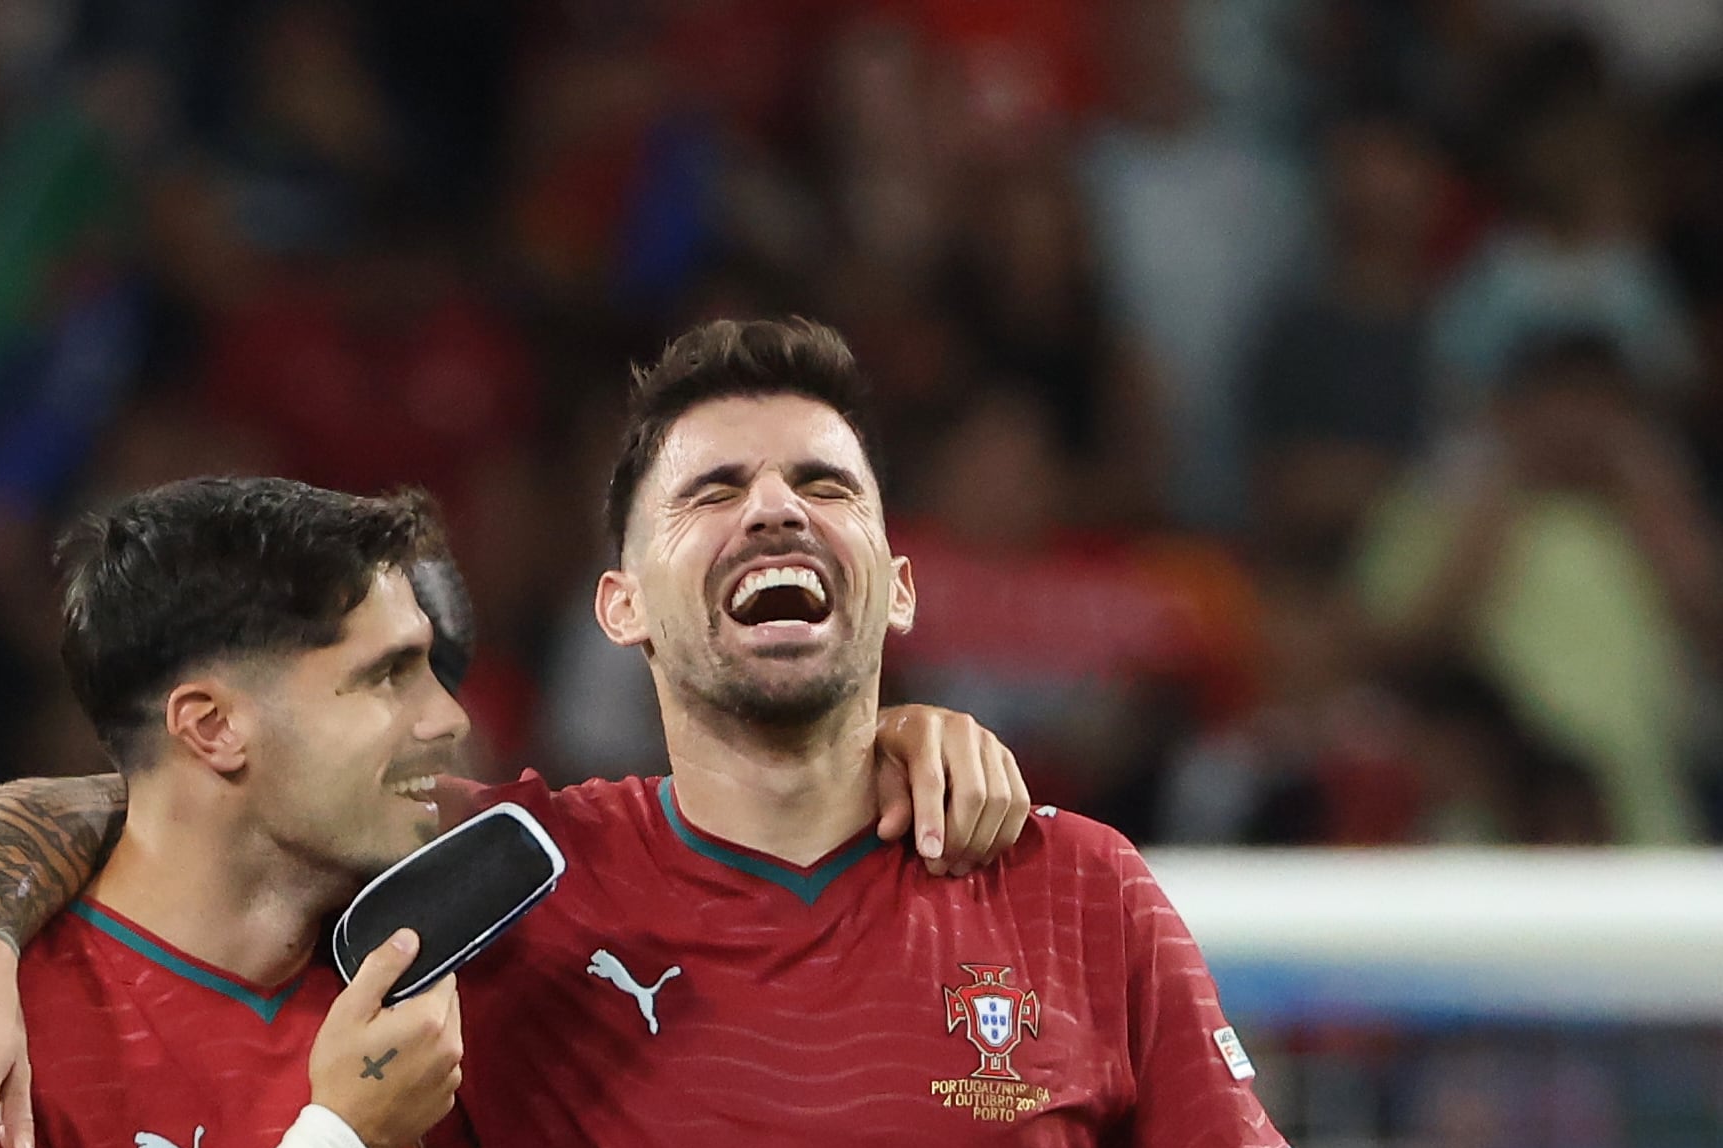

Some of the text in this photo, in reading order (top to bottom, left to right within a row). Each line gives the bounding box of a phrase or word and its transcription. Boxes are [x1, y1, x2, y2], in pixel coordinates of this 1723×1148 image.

[942, 1094, 952, 1108] 4
[955, 1093, 1014, 1109] OUTUBRO
[973, 1106, 1015, 1122] PORTO
